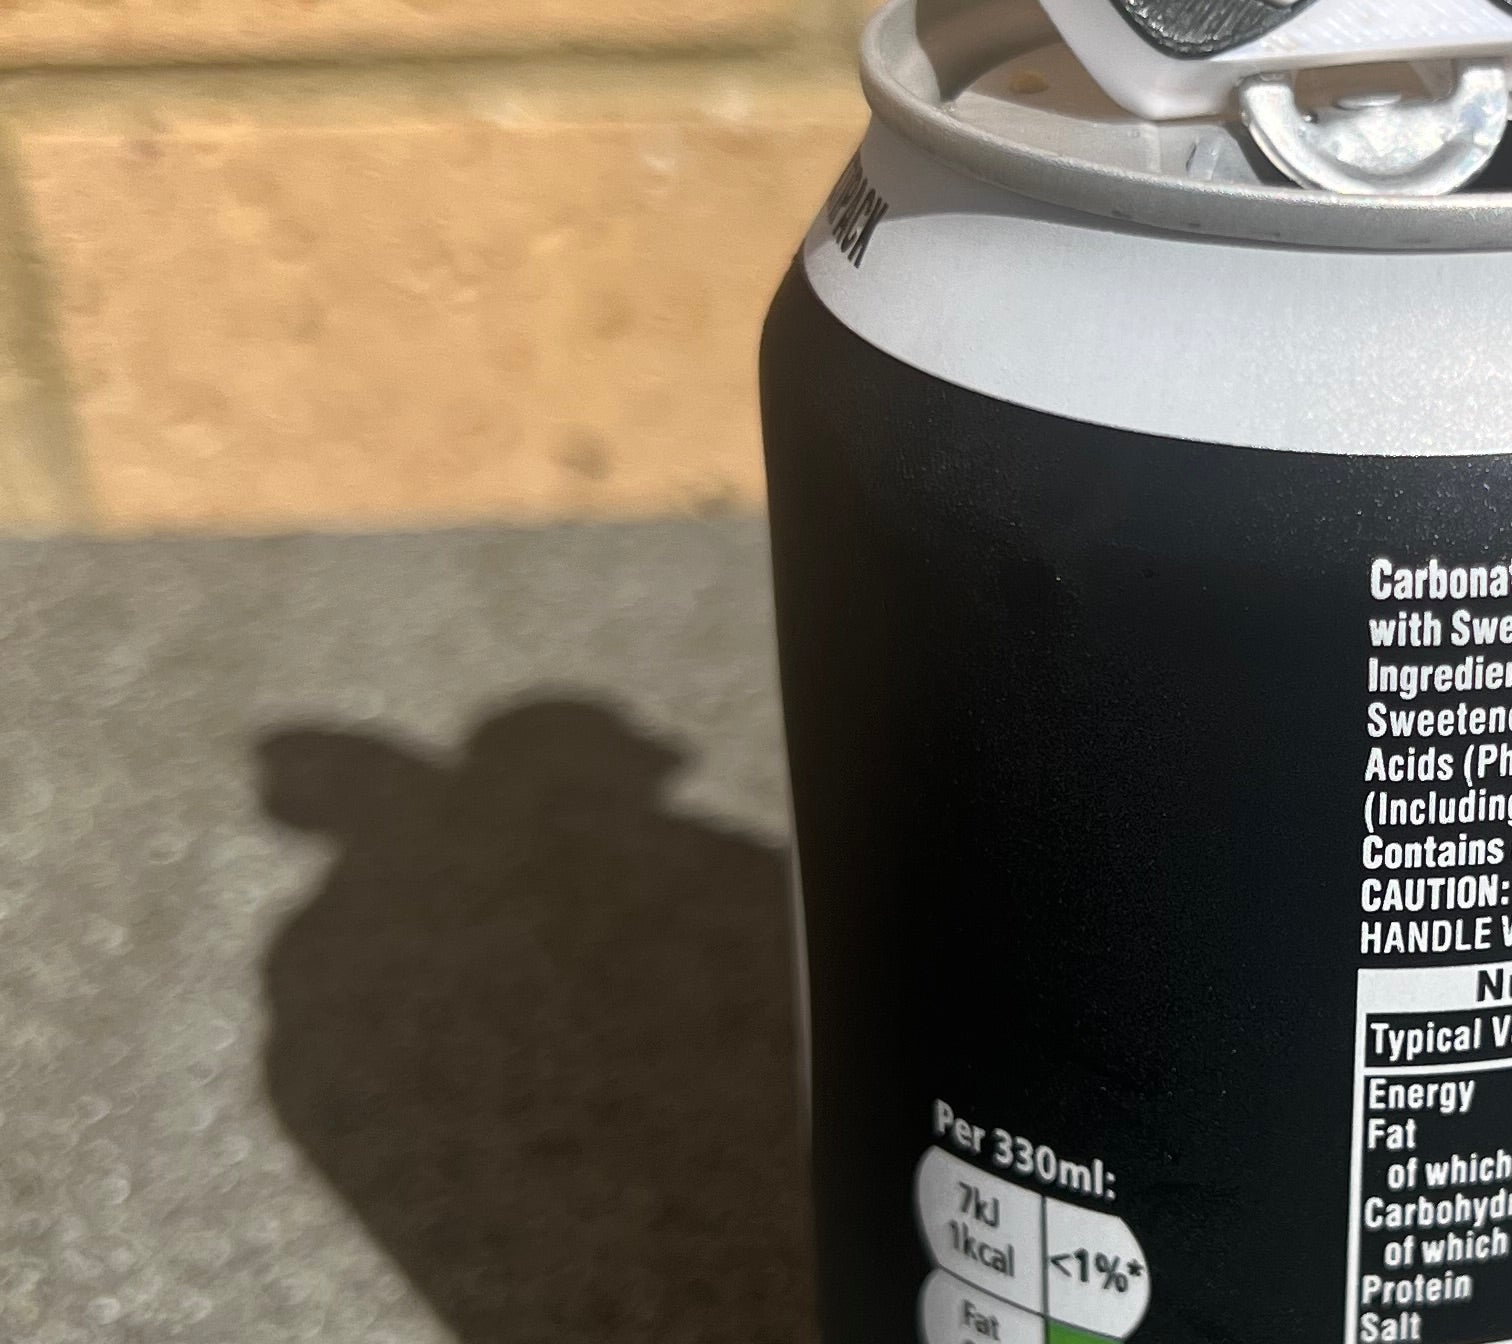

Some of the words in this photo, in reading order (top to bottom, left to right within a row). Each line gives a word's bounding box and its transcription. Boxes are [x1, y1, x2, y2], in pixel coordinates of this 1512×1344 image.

[1368, 609, 1442, 647] with
[1364, 746, 1454, 782] Acids
[1362, 833, 1504, 870] Contains
[1361, 873, 1510, 913] CAUTION:
[1360, 916, 1493, 954] HANDLE
[1369, 1017, 1482, 1062] Typical
[1368, 1078, 1475, 1113] Energy
[933, 1098, 985, 1154] Per
[992, 1127, 1116, 1200] 330ml:
[1367, 1118, 1416, 1150] Fat
[1387, 1156, 1418, 1189] of
[1425, 1150, 1512, 1187] which
[957, 1181, 1000, 1227] 7kJ
[1384, 1235, 1415, 1267] of
[1422, 1227, 1508, 1264] which
[1361, 1270, 1473, 1305] Protein
[961, 1299, 1000, 1340] Fat
[1360, 1312, 1421, 1343] Salt
